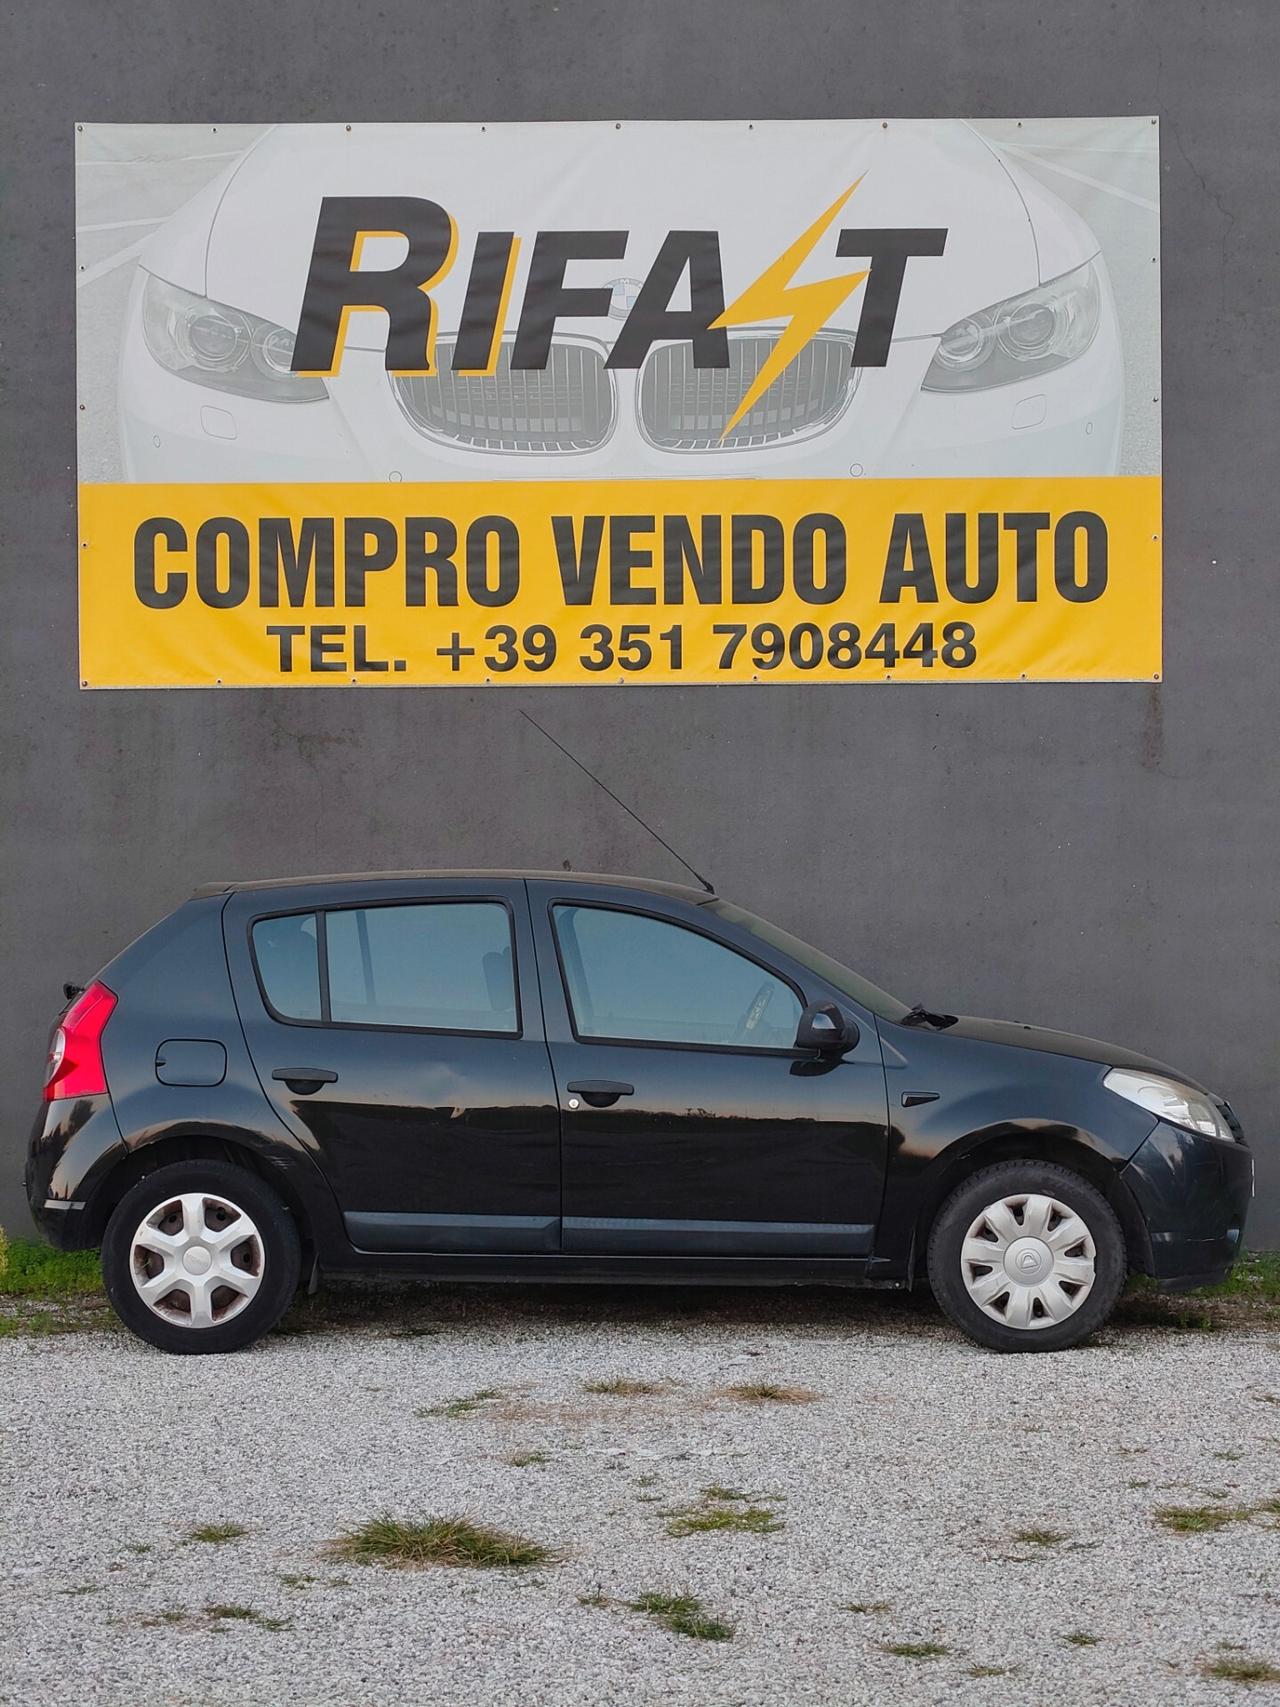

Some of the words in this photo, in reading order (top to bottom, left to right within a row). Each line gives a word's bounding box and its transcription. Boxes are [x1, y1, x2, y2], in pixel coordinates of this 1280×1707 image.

[133, 515, 520, 610] COMPRO
[550, 512, 847, 606] VENDO
[879, 510, 1108, 604] AUTO
[266, 625, 407, 673] TEL.
[436, 624, 557, 673] +39
[579, 624, 683, 672] 351
[712, 621, 977, 670] 7908448
